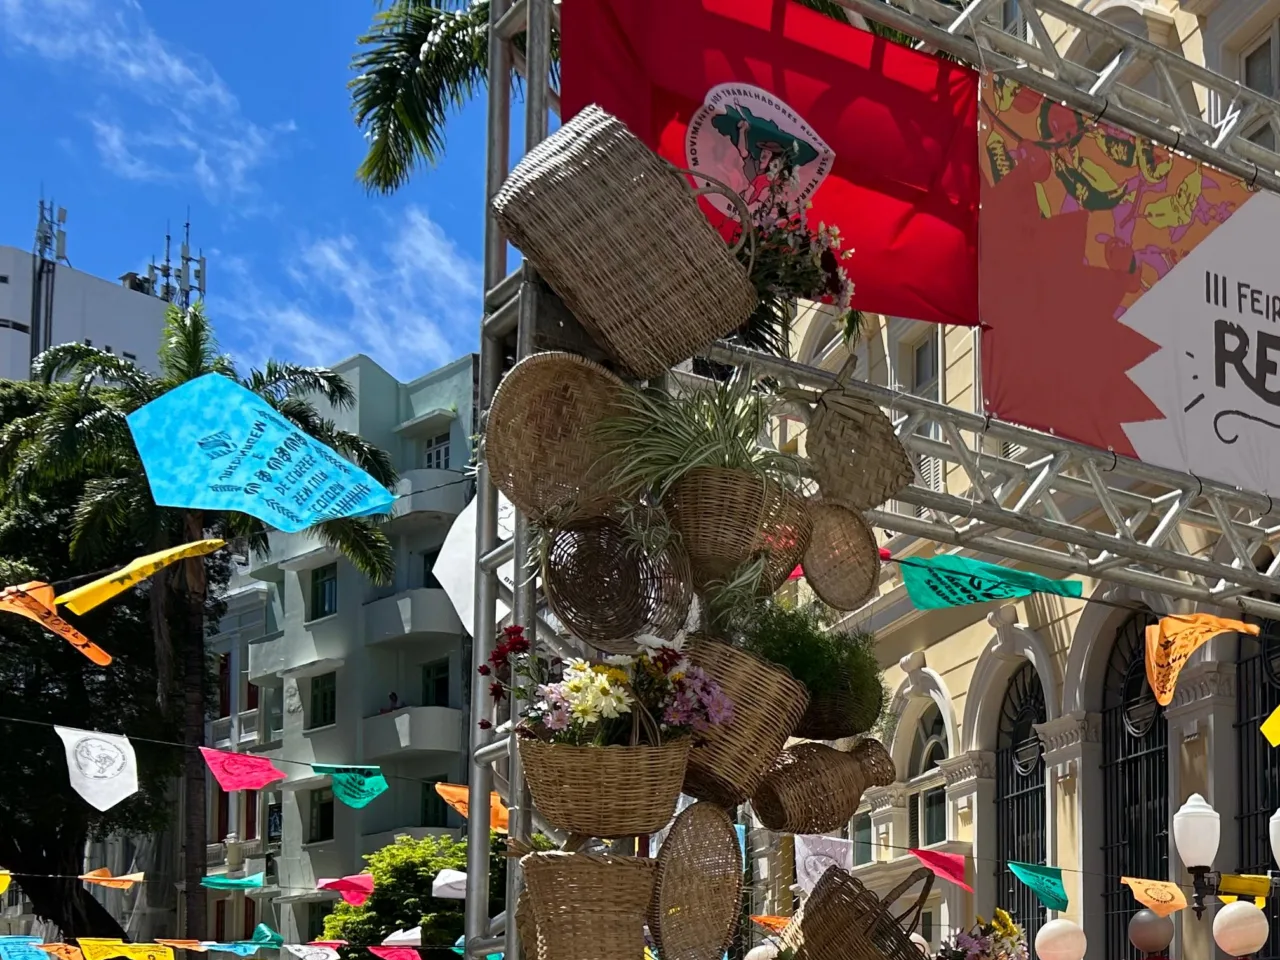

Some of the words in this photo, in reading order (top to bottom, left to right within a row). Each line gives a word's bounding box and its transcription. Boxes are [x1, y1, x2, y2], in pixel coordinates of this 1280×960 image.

[690, 104, 715, 167] MOVIMENTO
[721, 88, 798, 124] TRABALHADORES
[1206, 270, 1228, 309] III
